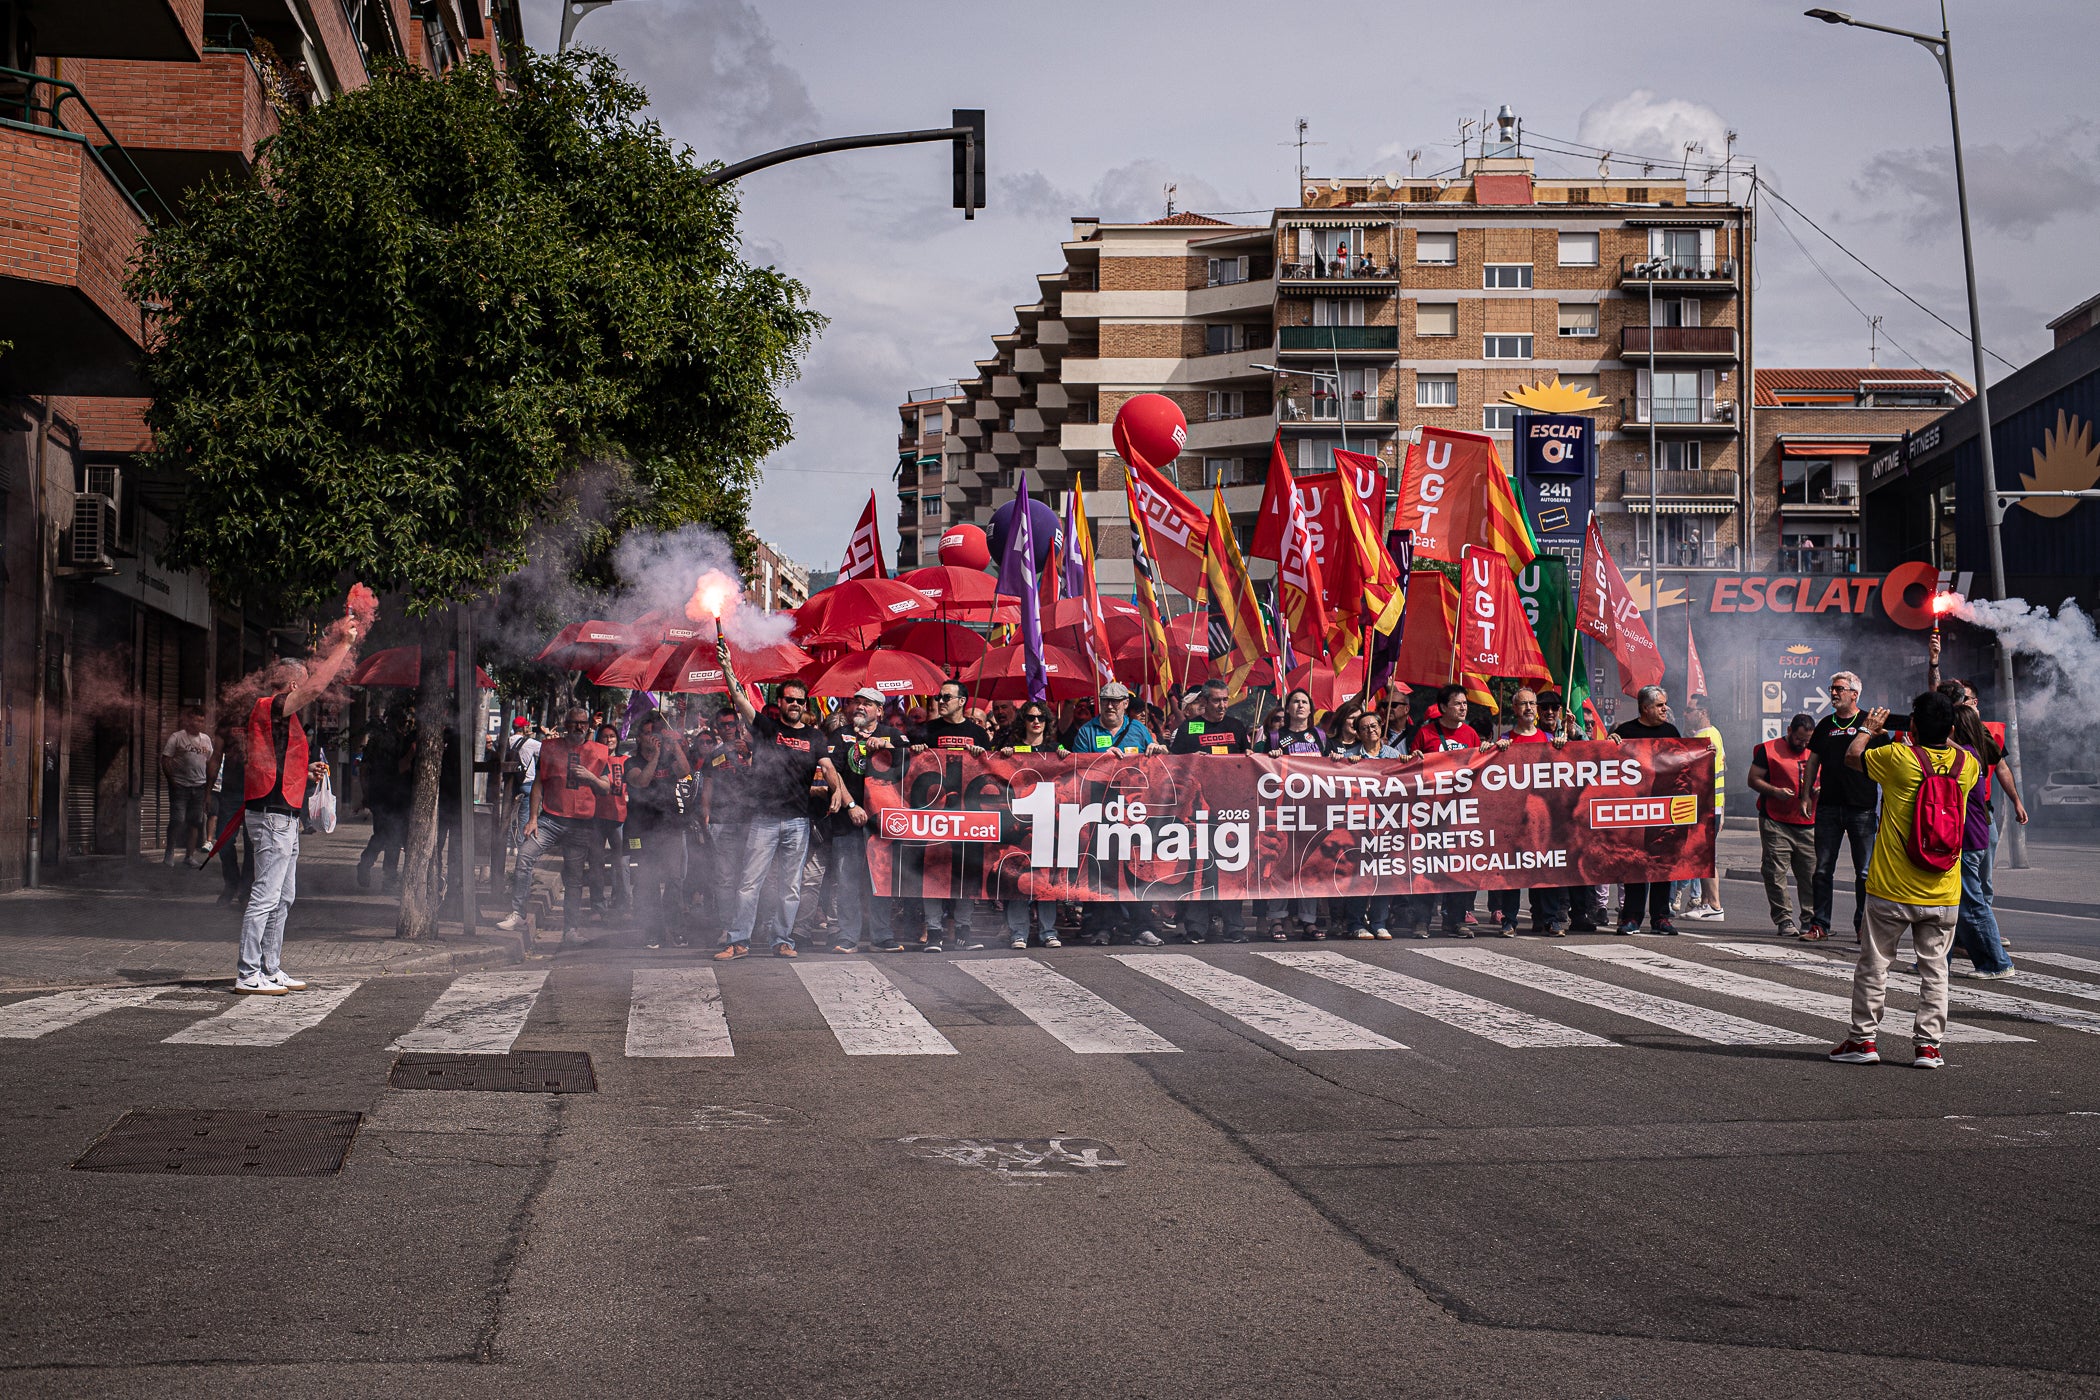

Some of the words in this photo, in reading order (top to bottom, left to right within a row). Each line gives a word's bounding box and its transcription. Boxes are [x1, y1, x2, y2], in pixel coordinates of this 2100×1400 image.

[1530, 424, 1583, 439] ESCLAT
[1872, 449, 1900, 480] ANYTIME
[1909, 426, 1940, 459] FITNESS
[1418, 440, 1453, 534] UGT
[1540, 482, 1571, 497] 24h
[1472, 557, 1496, 650] UGT
[1710, 577, 1881, 613] ESCLAT
[1589, 620, 1609, 636] .cat
[1474, 652, 1499, 665] .cat
[1779, 655, 1820, 666] ESCLAT
[939, 737, 964, 746] CCOO
[1201, 735, 1224, 743] CCOO
[1258, 772, 1407, 799] CONTRA
[1417, 769, 1473, 797] LES
[1481, 759, 1642, 792] GUERRES
[1105, 795, 1147, 822] de
[1217, 809, 1250, 820] 2026
[1258, 806, 1266, 832] I
[1272, 806, 1317, 831] EL
[1327, 798, 1480, 831] FEIXISME
[1596, 803, 1665, 822] CCOO
[912, 814, 996, 838] UGT.cat
[1012, 782, 1103, 868] 1r
[1096, 810, 1250, 872] maig
[1360, 830, 1406, 853] MÉS
[1410, 831, 1484, 850] DRETS
[1489, 829, 1495, 847] I
[1360, 855, 1406, 877] MÉS
[1411, 850, 1567, 875] SINDICALISME
